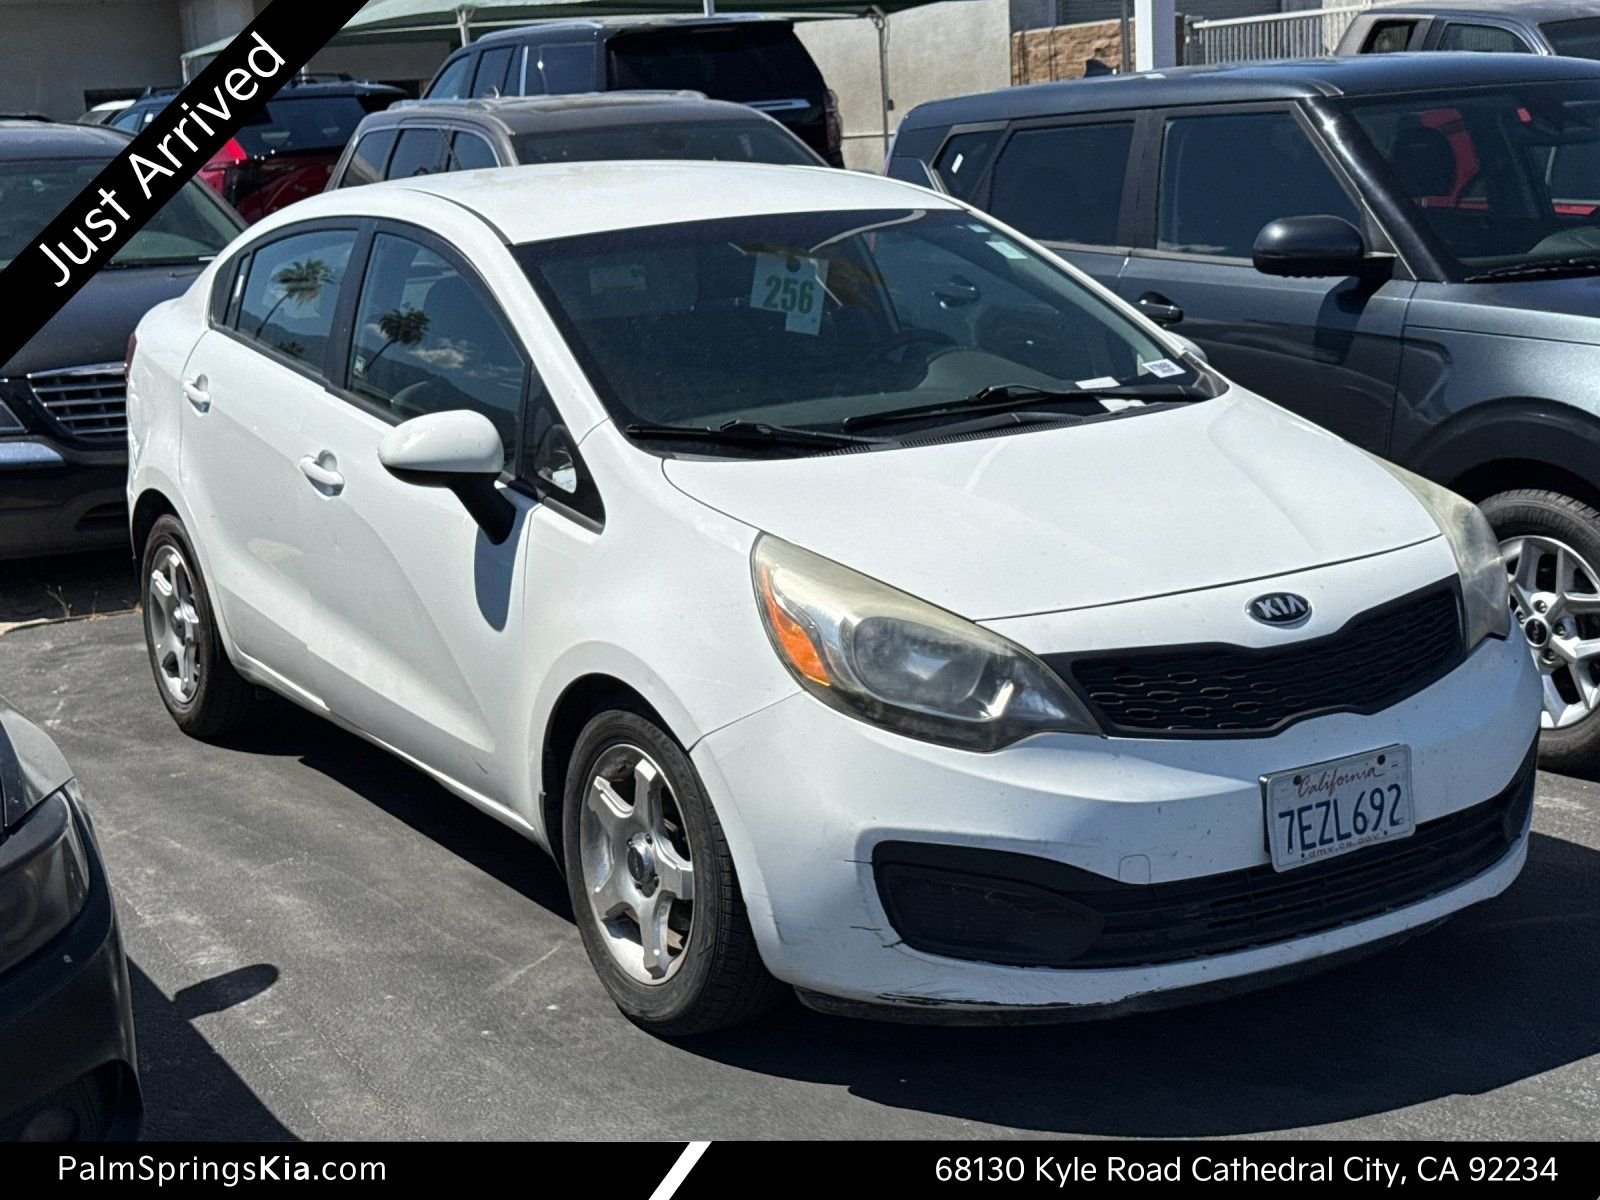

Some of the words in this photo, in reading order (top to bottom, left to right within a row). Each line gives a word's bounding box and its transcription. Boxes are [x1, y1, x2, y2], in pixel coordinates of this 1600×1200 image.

[762, 274, 815, 314] 256
[1256, 595, 1306, 619] KIA
[1297, 762, 1385, 799] California
[1278, 783, 1403, 855] 7EZL692
